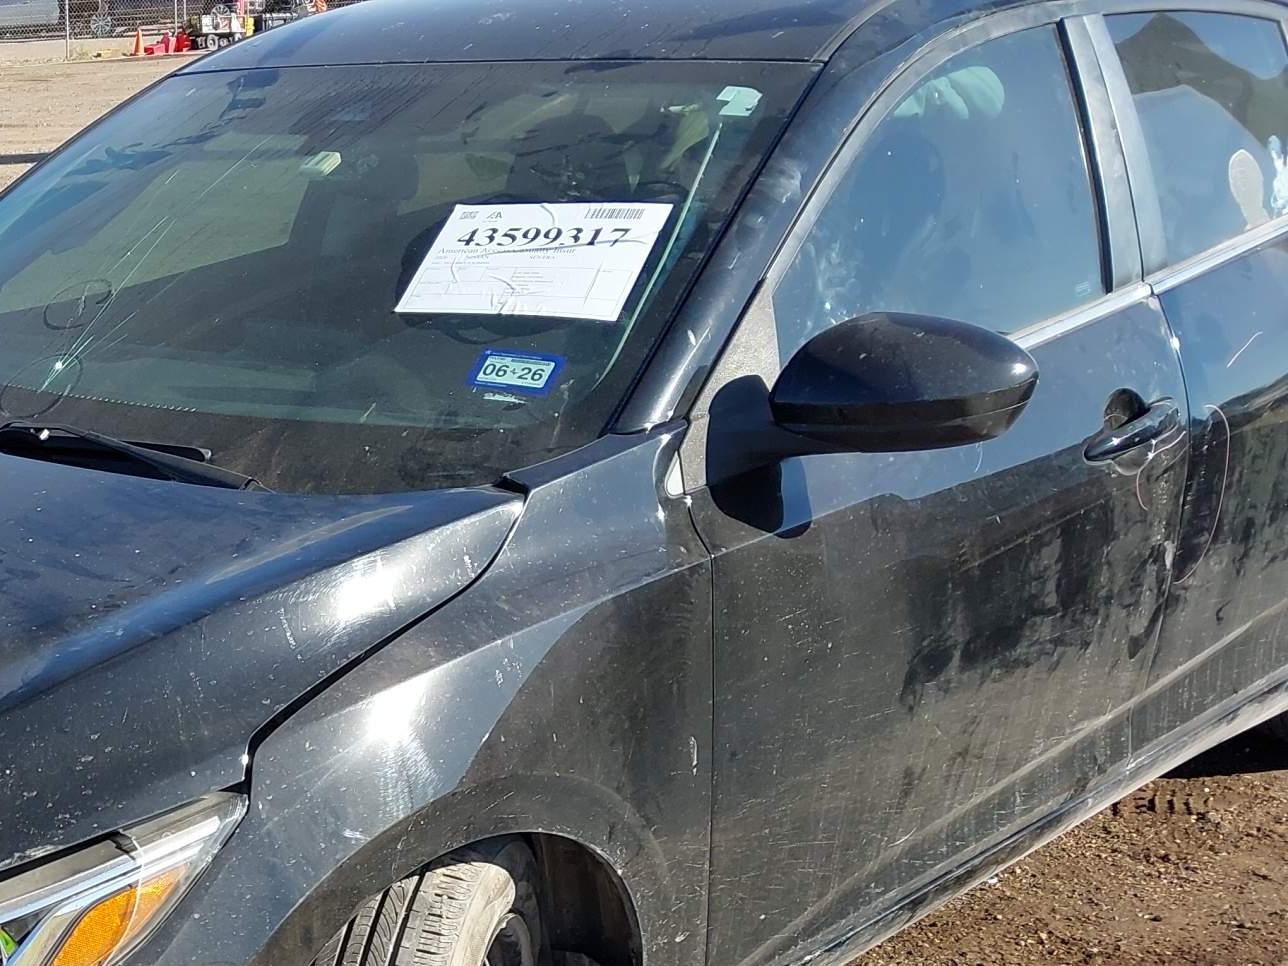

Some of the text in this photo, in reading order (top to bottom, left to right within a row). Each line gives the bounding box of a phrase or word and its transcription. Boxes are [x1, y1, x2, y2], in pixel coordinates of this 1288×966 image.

[457, 226, 632, 247] 43599317
[482, 363, 545, 382] 06 26
